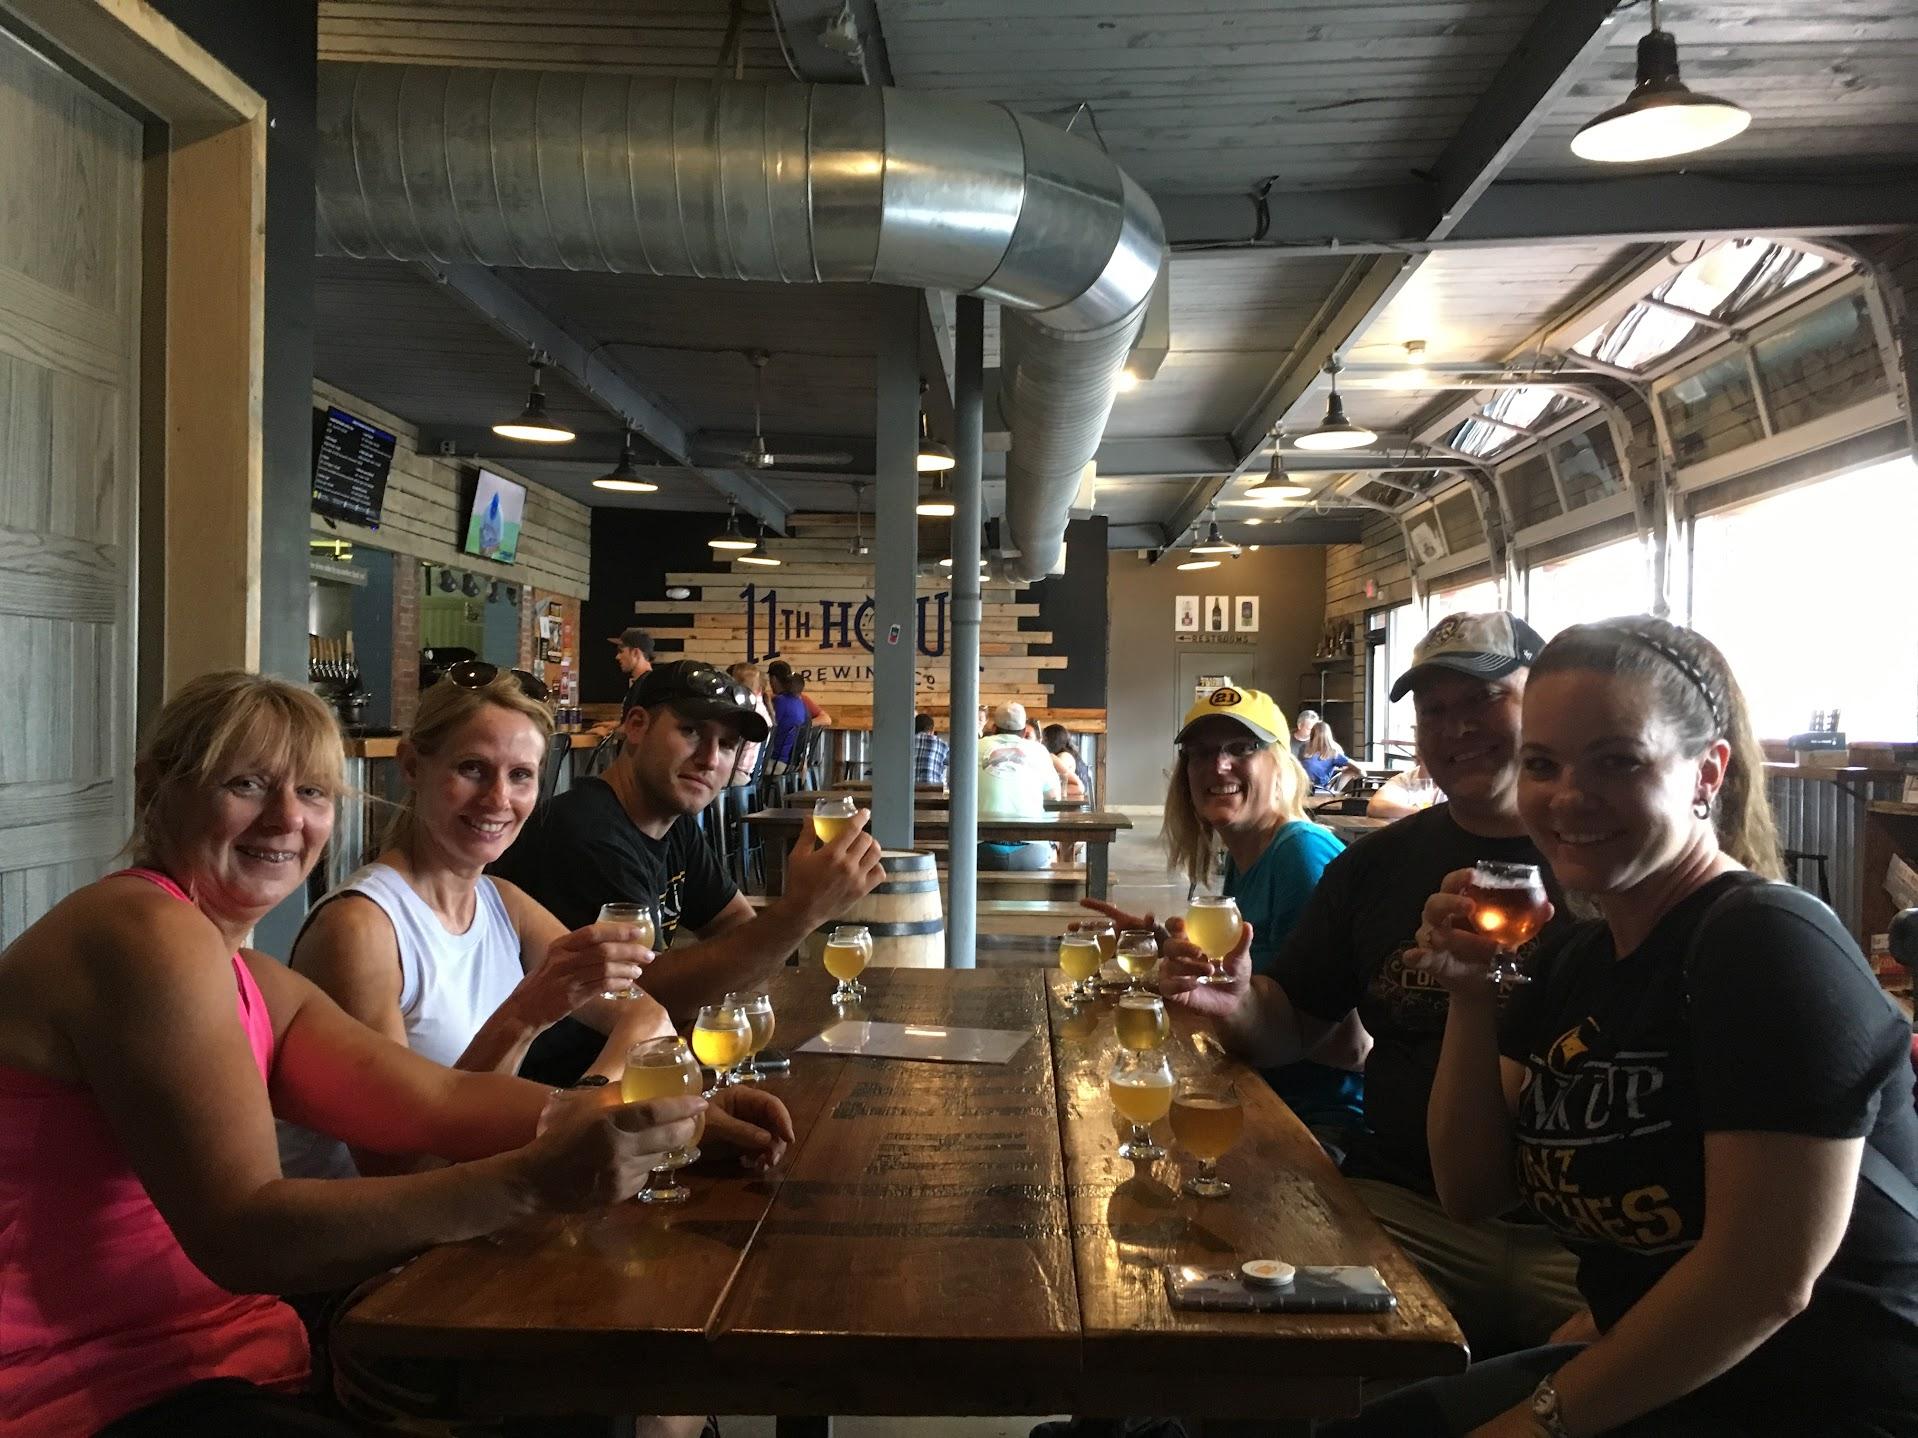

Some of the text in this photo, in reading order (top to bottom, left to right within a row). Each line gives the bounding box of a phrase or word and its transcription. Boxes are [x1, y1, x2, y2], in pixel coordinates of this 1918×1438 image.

[739, 582, 951, 665] 11TH HU
[1191, 634, 1249, 644] RESTROOMS
[802, 665, 875, 682] REWIN
[1214, 692, 1235, 703] 21
